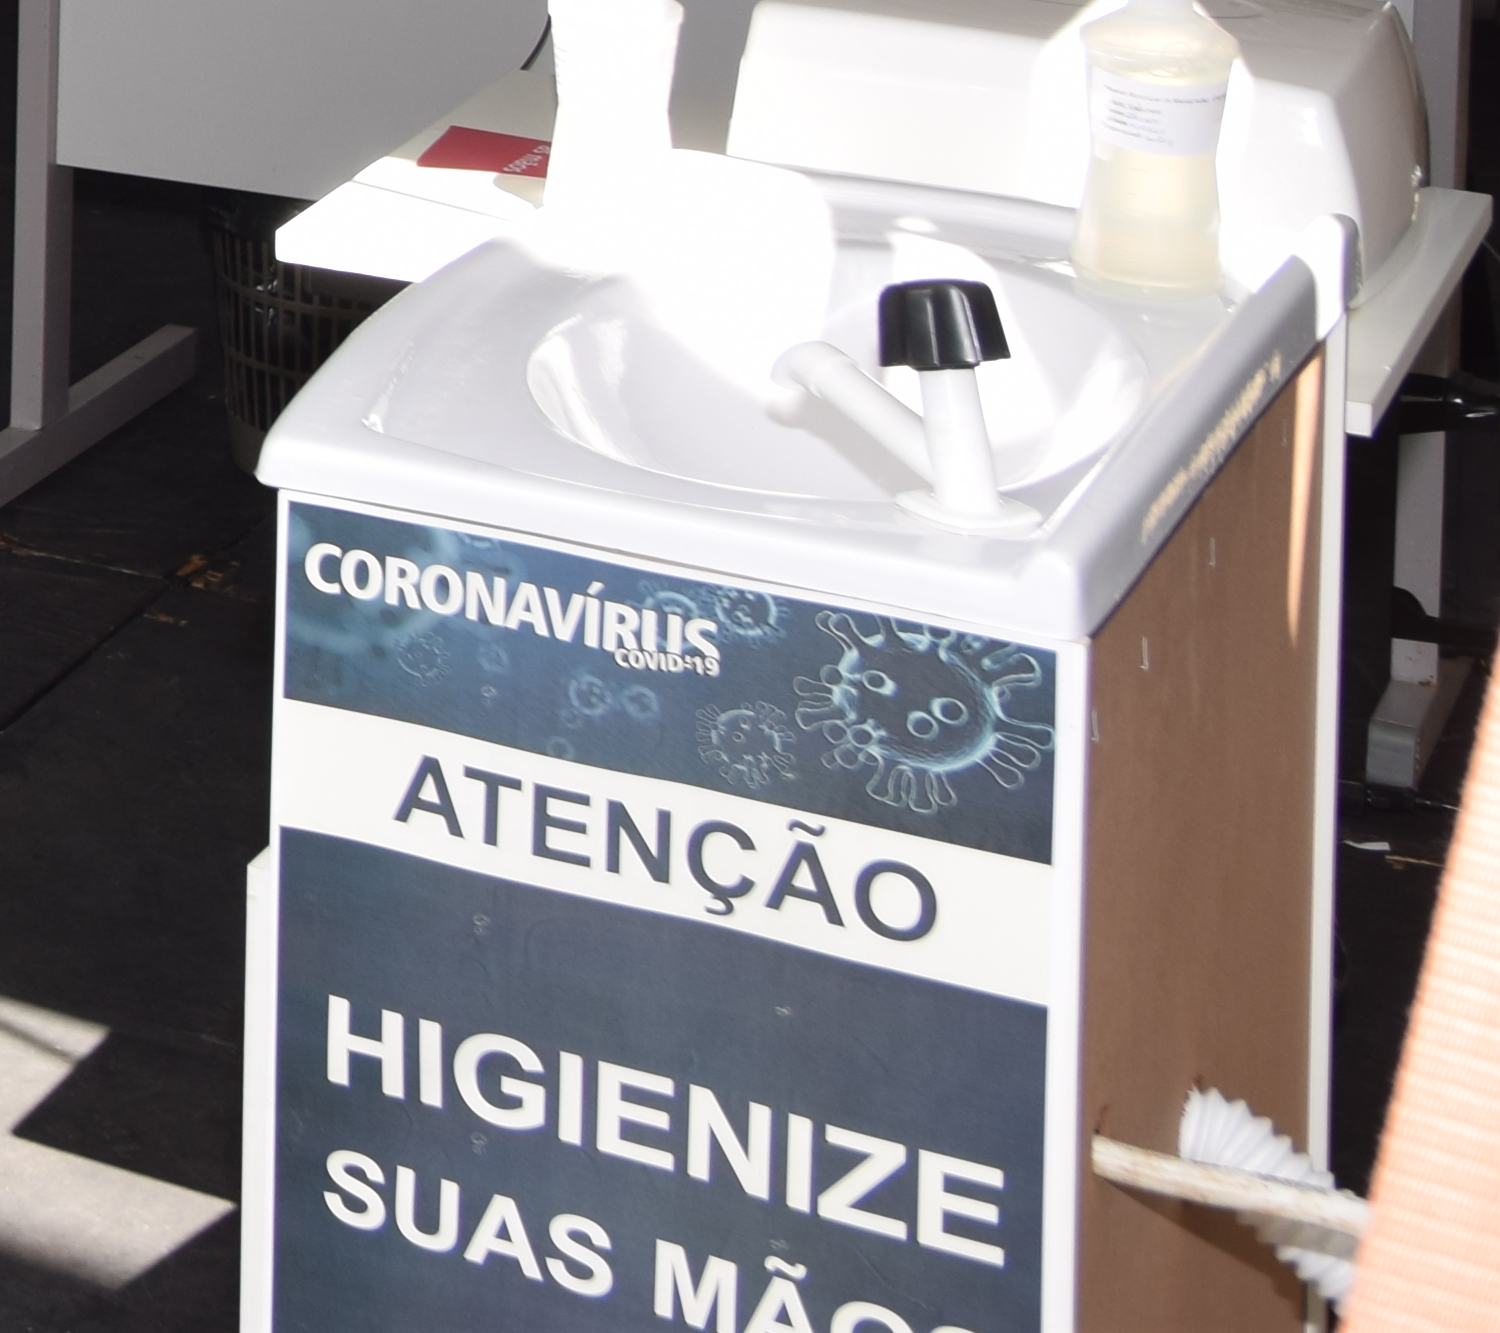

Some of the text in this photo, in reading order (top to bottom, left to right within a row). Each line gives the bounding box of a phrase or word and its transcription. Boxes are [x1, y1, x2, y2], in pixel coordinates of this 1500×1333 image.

[304, 542, 721, 663] CORONAVÍRUS
[614, 648, 720, 677] COVID-19
[395, 756, 938, 941] ATENÇÃO
[326, 996, 1005, 1266] HIGIENIZE
[323, 1149, 985, 1333] SUAS MÃ
